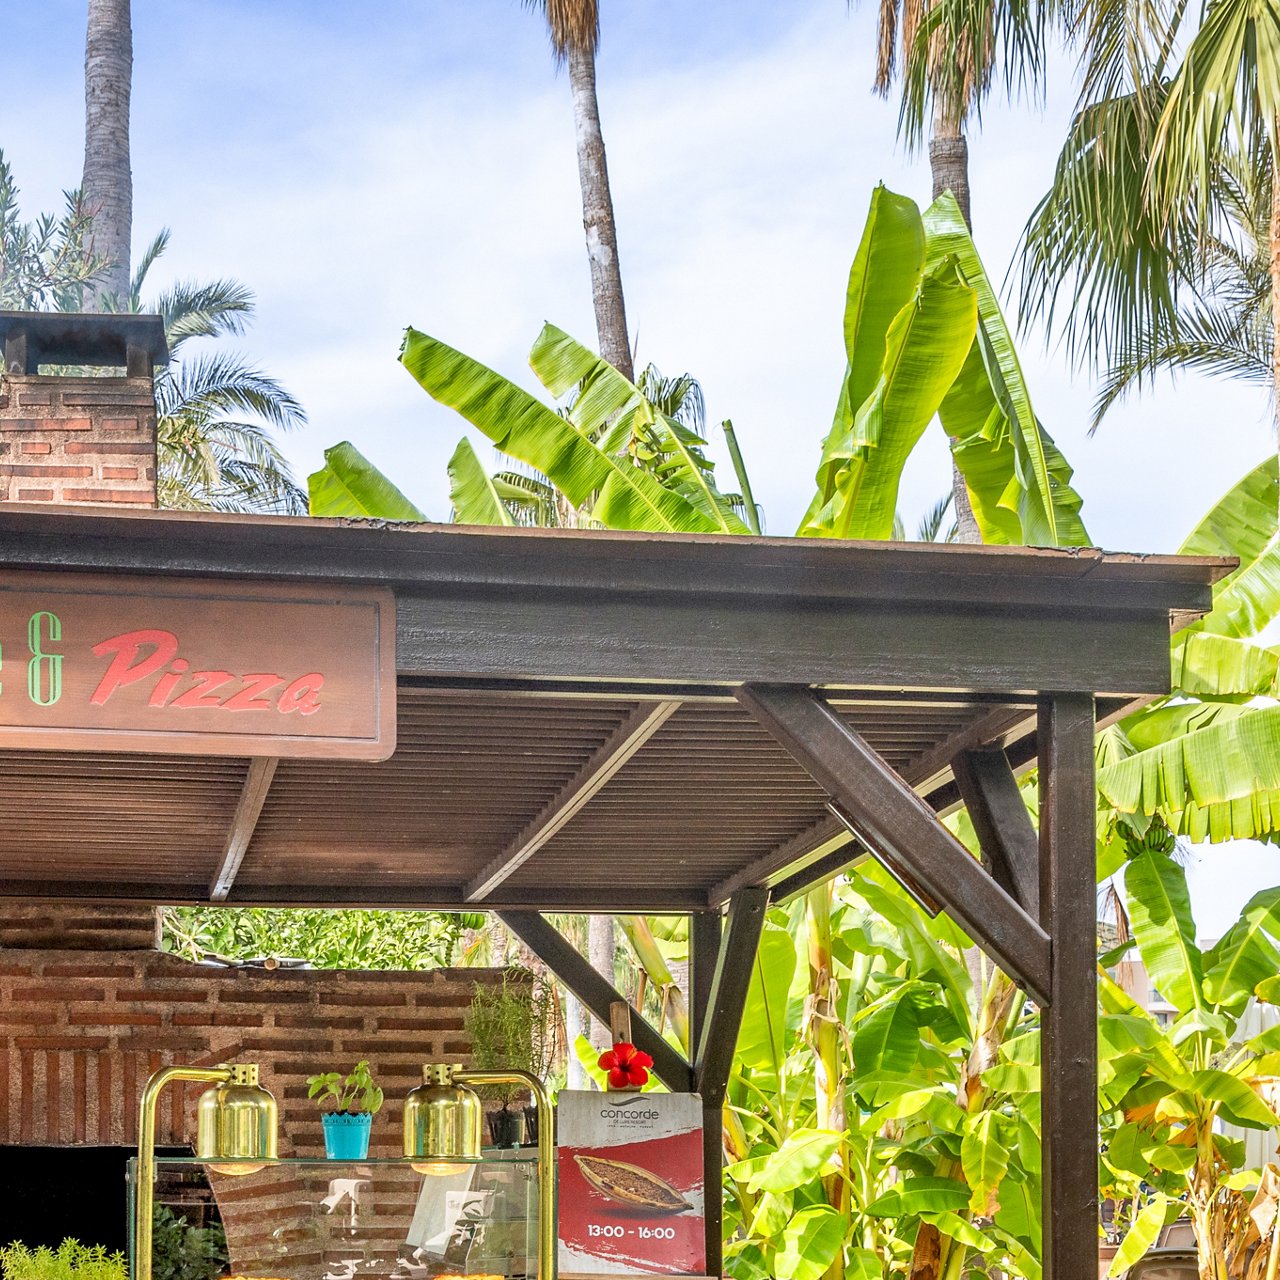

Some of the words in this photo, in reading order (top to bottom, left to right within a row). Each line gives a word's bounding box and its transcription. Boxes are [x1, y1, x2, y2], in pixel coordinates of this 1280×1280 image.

[89, 629, 326, 716] Pizza
[600, 1108, 660, 1120] concorde
[587, 1224, 625, 1238] 13:00
[638, 1226, 675, 1240] 16:00
